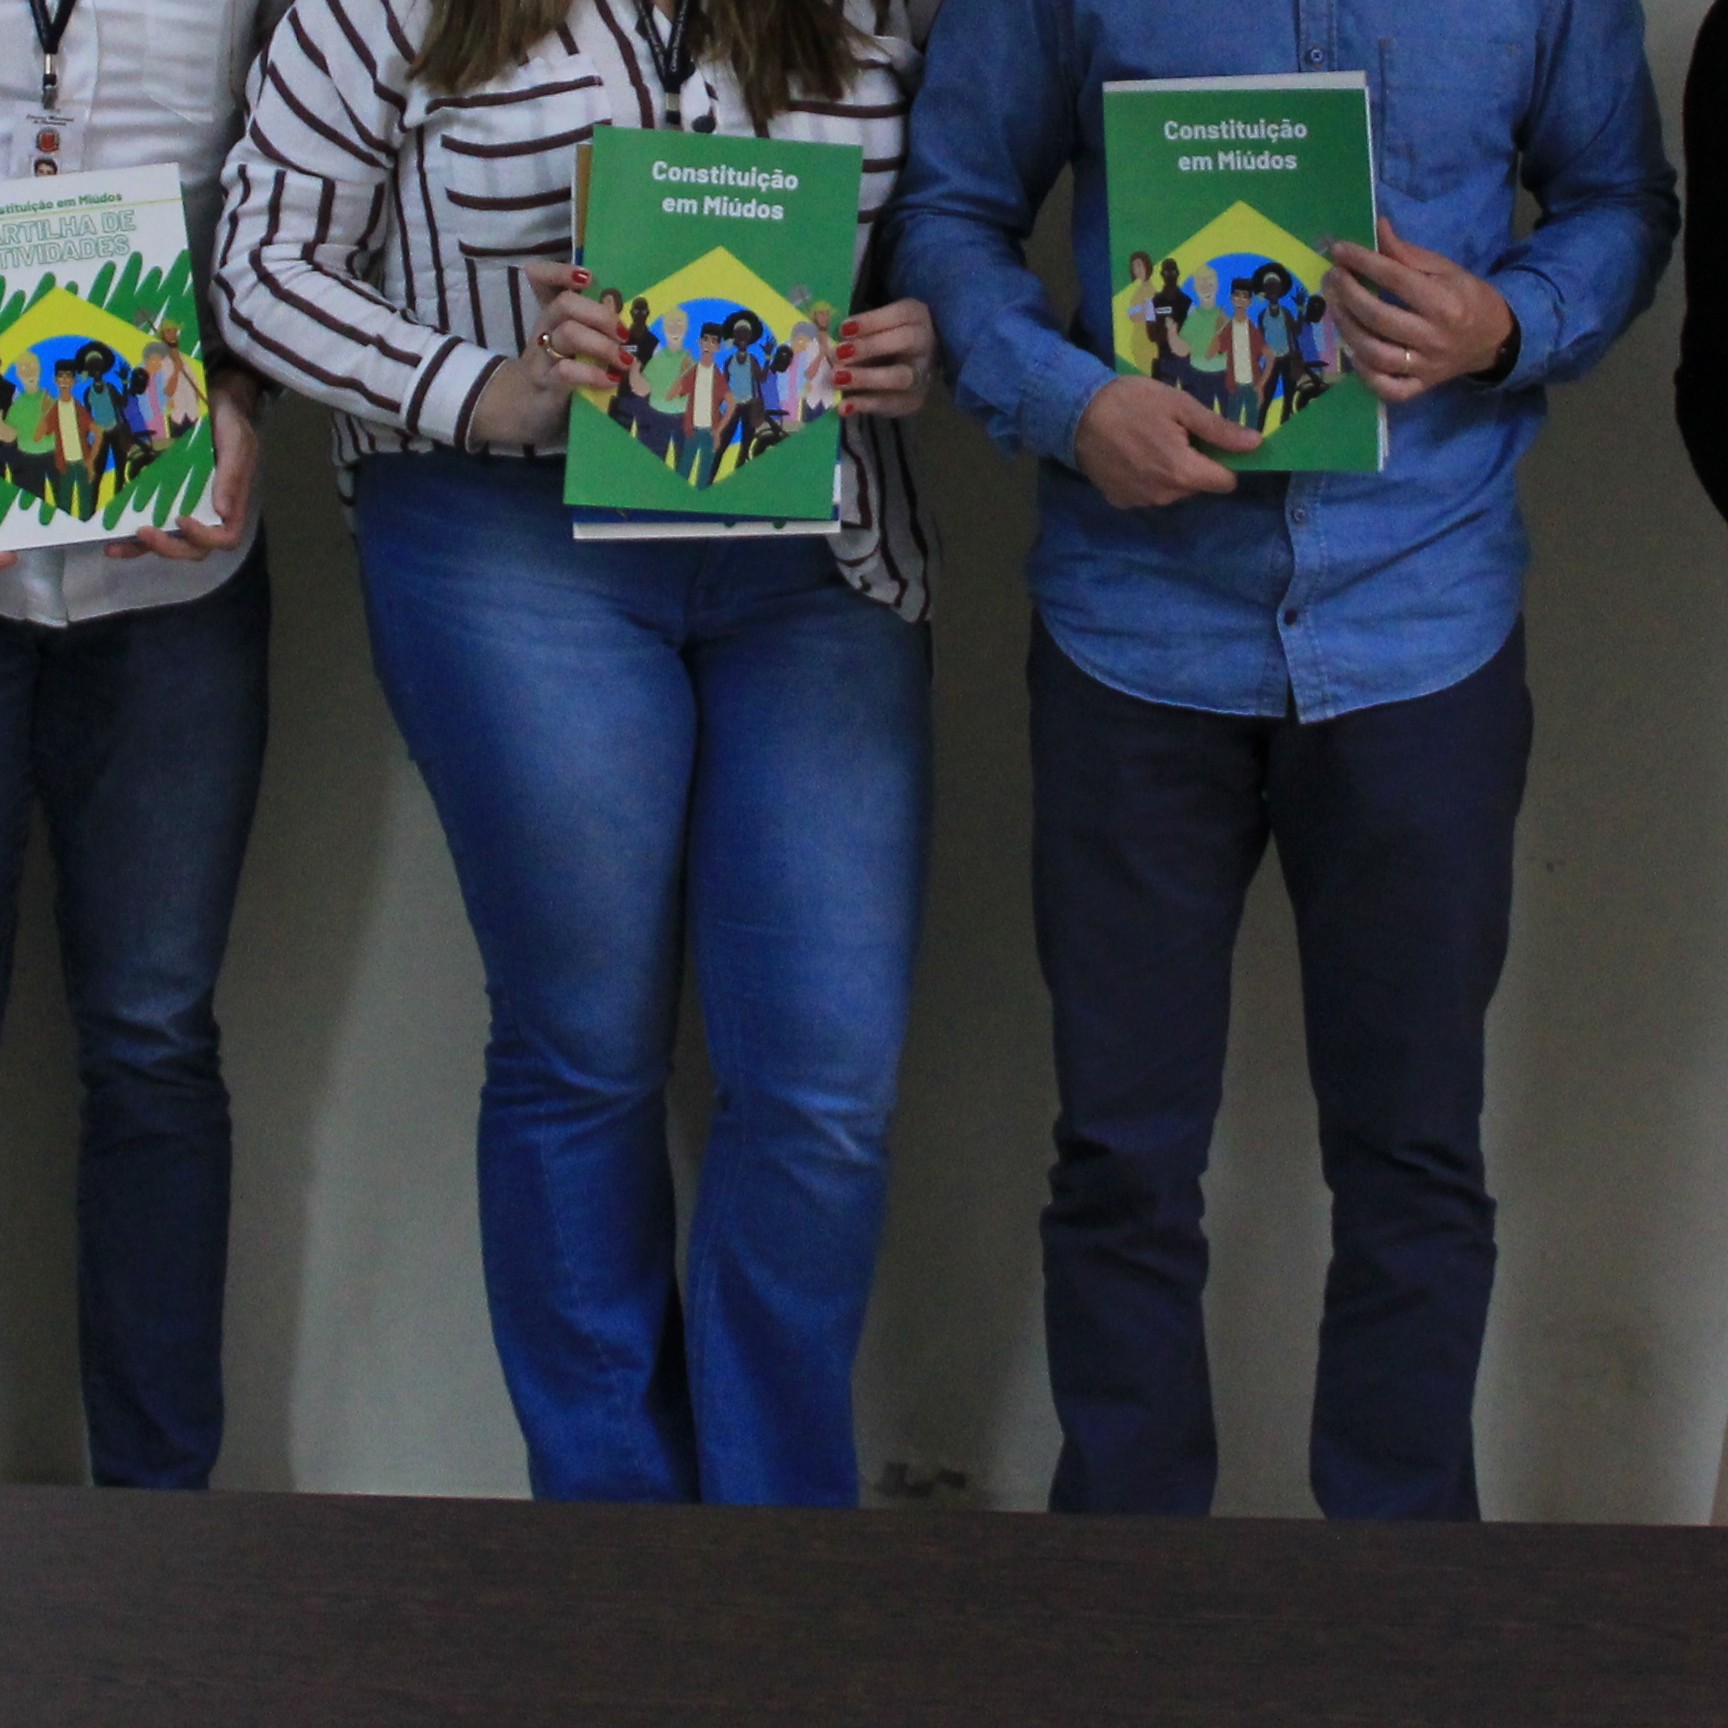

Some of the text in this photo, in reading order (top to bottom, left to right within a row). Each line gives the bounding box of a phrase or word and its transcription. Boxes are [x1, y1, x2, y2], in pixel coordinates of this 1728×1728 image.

[1163, 118, 1308, 143] Constituição
[1177, 150, 1298, 171] em Miúdos
[652, 160, 799, 192] Constituição
[56, 197, 77, 208] em
[661, 195, 785, 220] em Miúdos
[101, 209, 137, 234] DE
